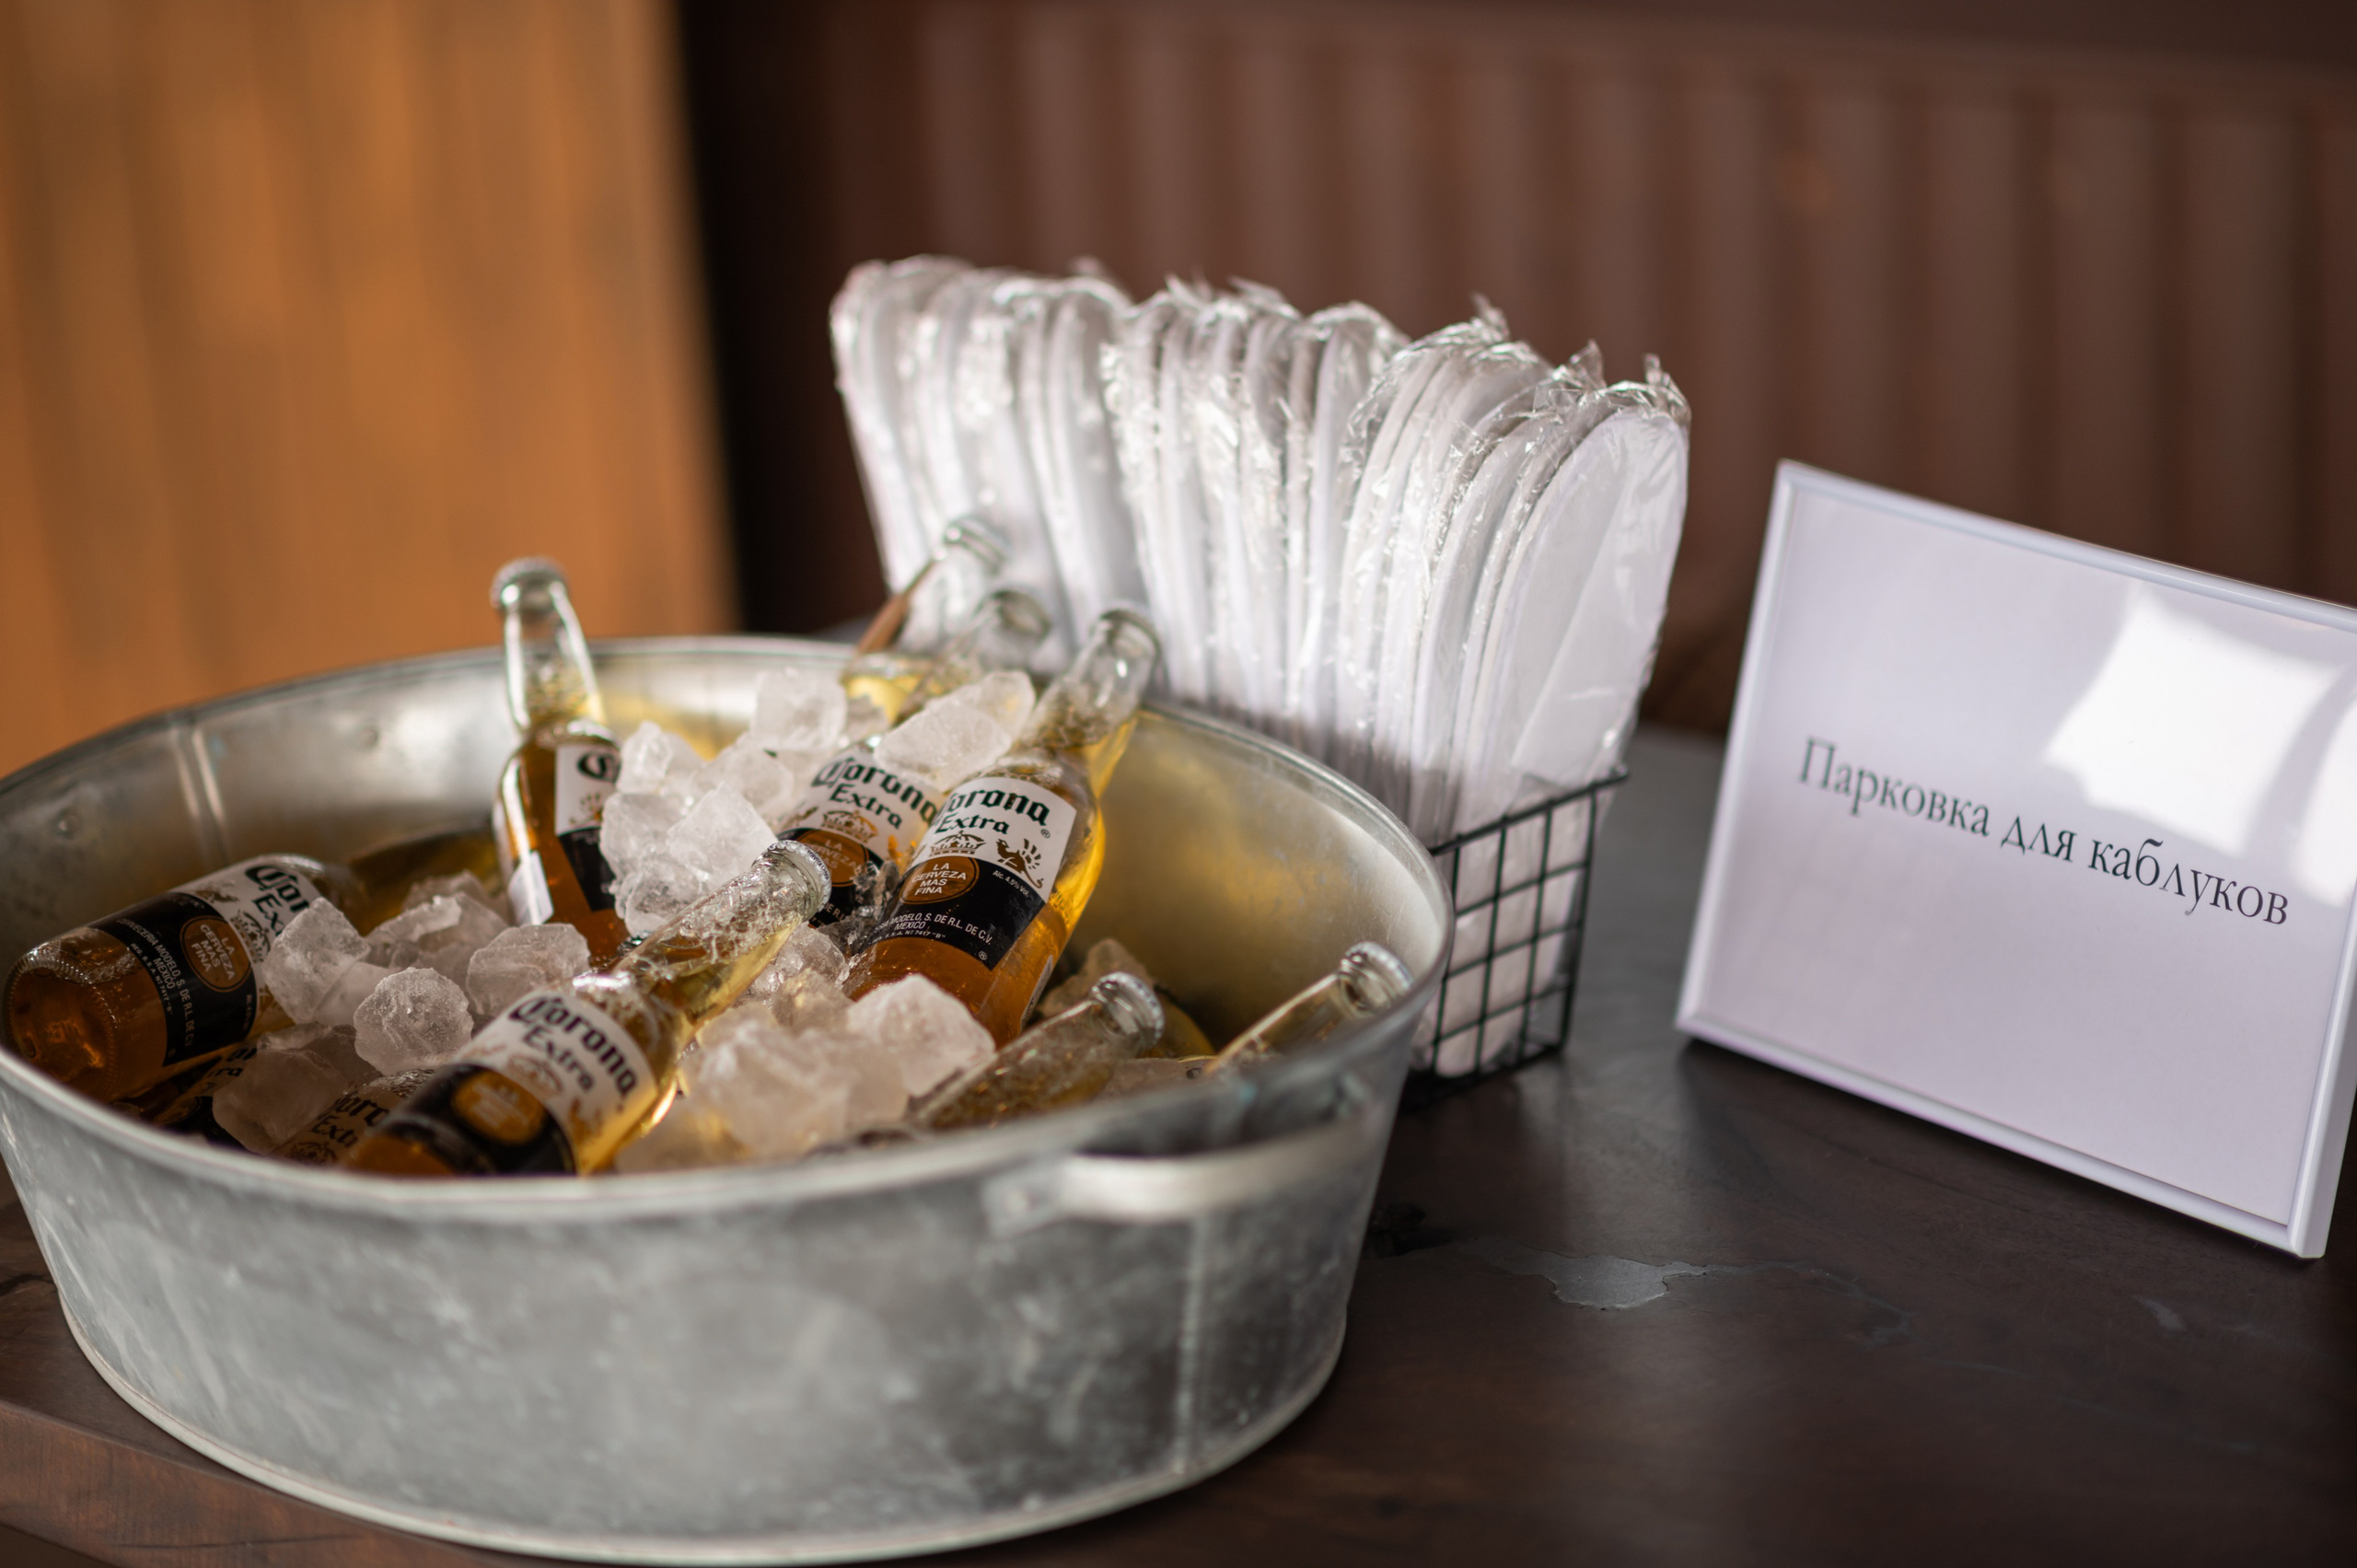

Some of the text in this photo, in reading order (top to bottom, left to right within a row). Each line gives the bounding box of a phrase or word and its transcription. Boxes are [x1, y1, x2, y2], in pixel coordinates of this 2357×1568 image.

[810, 757, 938, 828] Corona
[830, 783, 903, 830] Extra
[935, 812, 1010, 834] Extra
[1797, 737, 2291, 925] Парковка для каблуков
[911, 870, 967, 883] CERVEZA
[933, 863, 949, 871] LA
[245, 865, 310, 912] Cor
[914, 887, 943, 896] FINA
[920, 878, 947, 888] MAS
[894, 921, 926, 931] MEXICO
[923, 912, 932, 922] S.
[934, 914, 948, 924] DE
[947, 917, 963, 929] R.L.
[965, 923, 979, 935] DE
[978, 930, 993, 946] C.V.
[191, 942, 213, 972] FINA
[200, 923, 236, 981] CERVEZA
[201, 939, 221, 968] MAS
[220, 936, 236, 956] LA
[180, 989, 192, 1005] DE
[509, 996, 637, 1098] Corona
[522, 1025, 595, 1093] Extra
